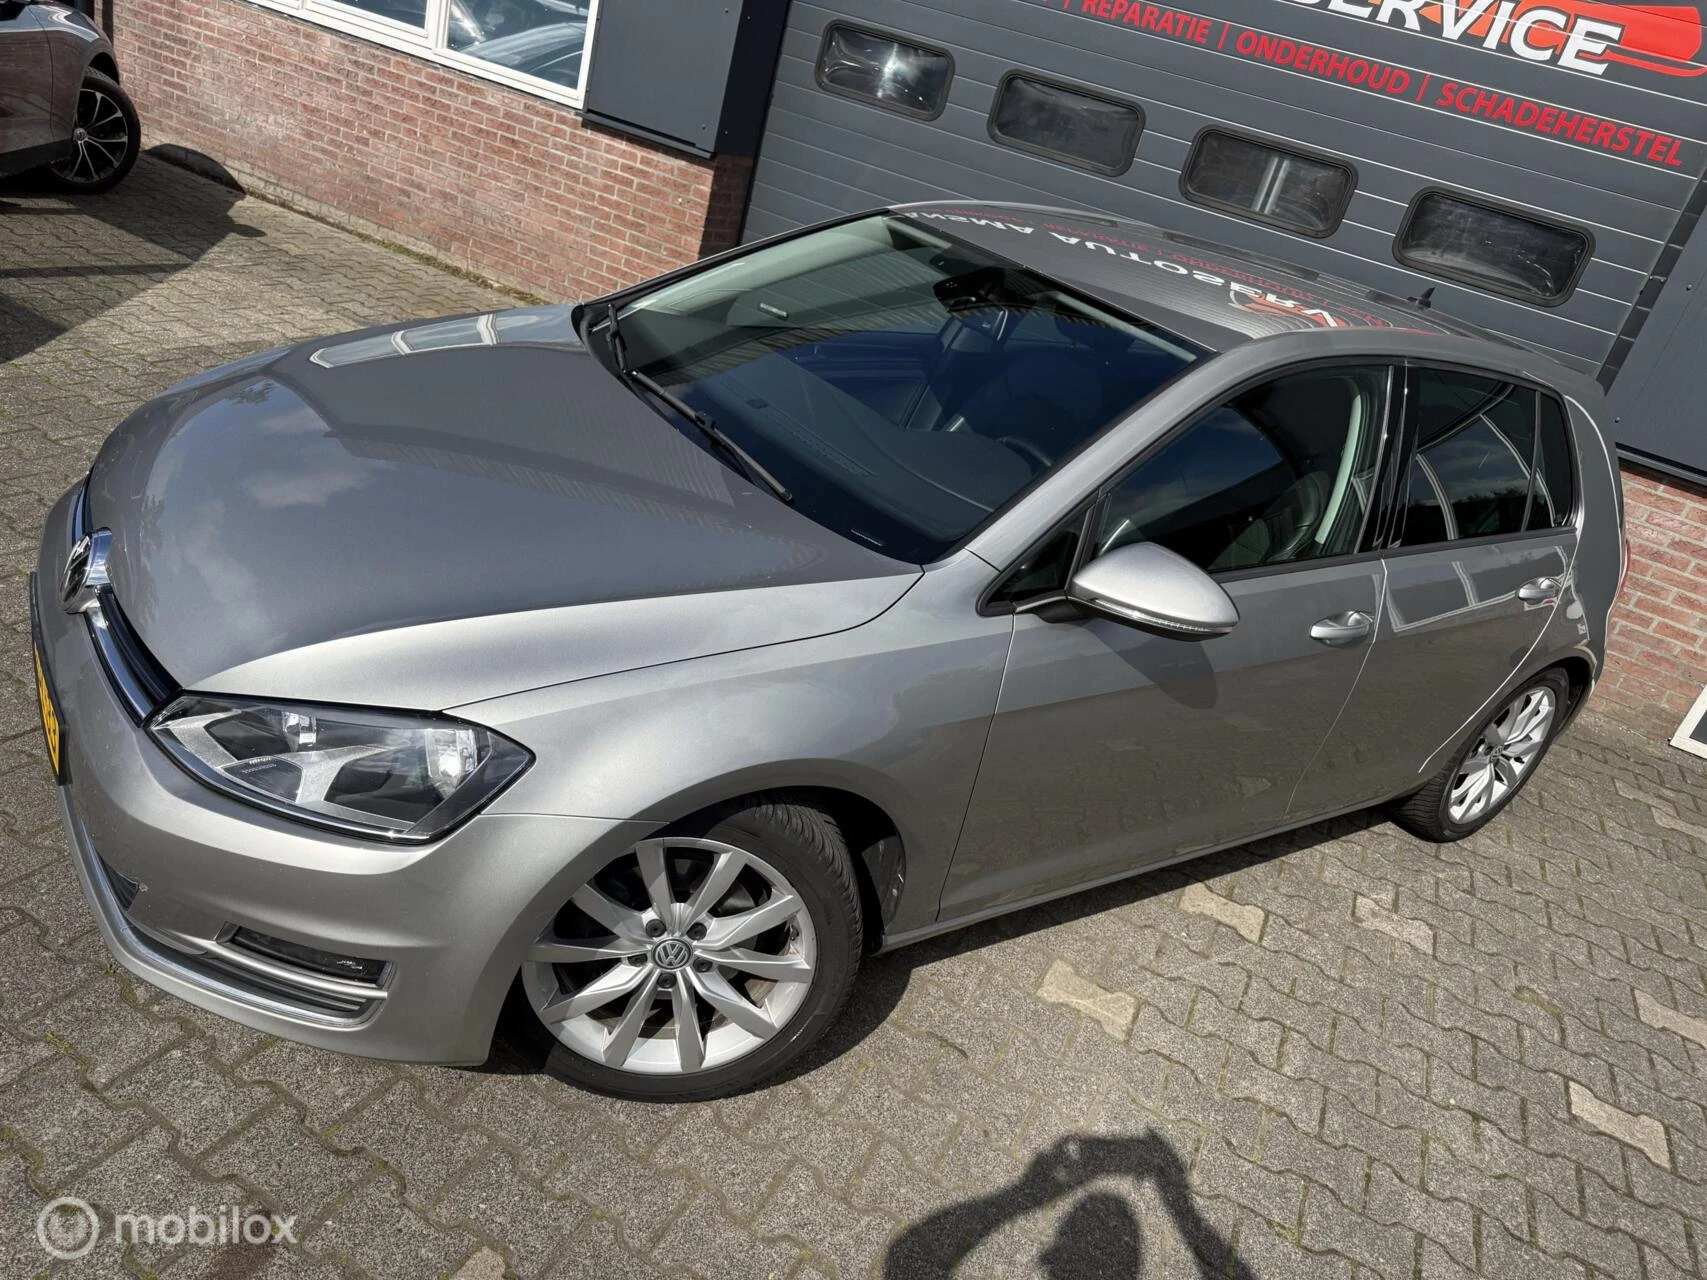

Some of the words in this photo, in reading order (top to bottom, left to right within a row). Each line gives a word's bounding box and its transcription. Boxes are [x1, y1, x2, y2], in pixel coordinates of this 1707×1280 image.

[1081, 0, 1213, 44] REPARATIE
[1236, 30, 1410, 94] ONDERHOUD
[1437, 82, 1682, 166] SCHADEHERSTEL
[1291, 0, 1622, 76] RVICE
